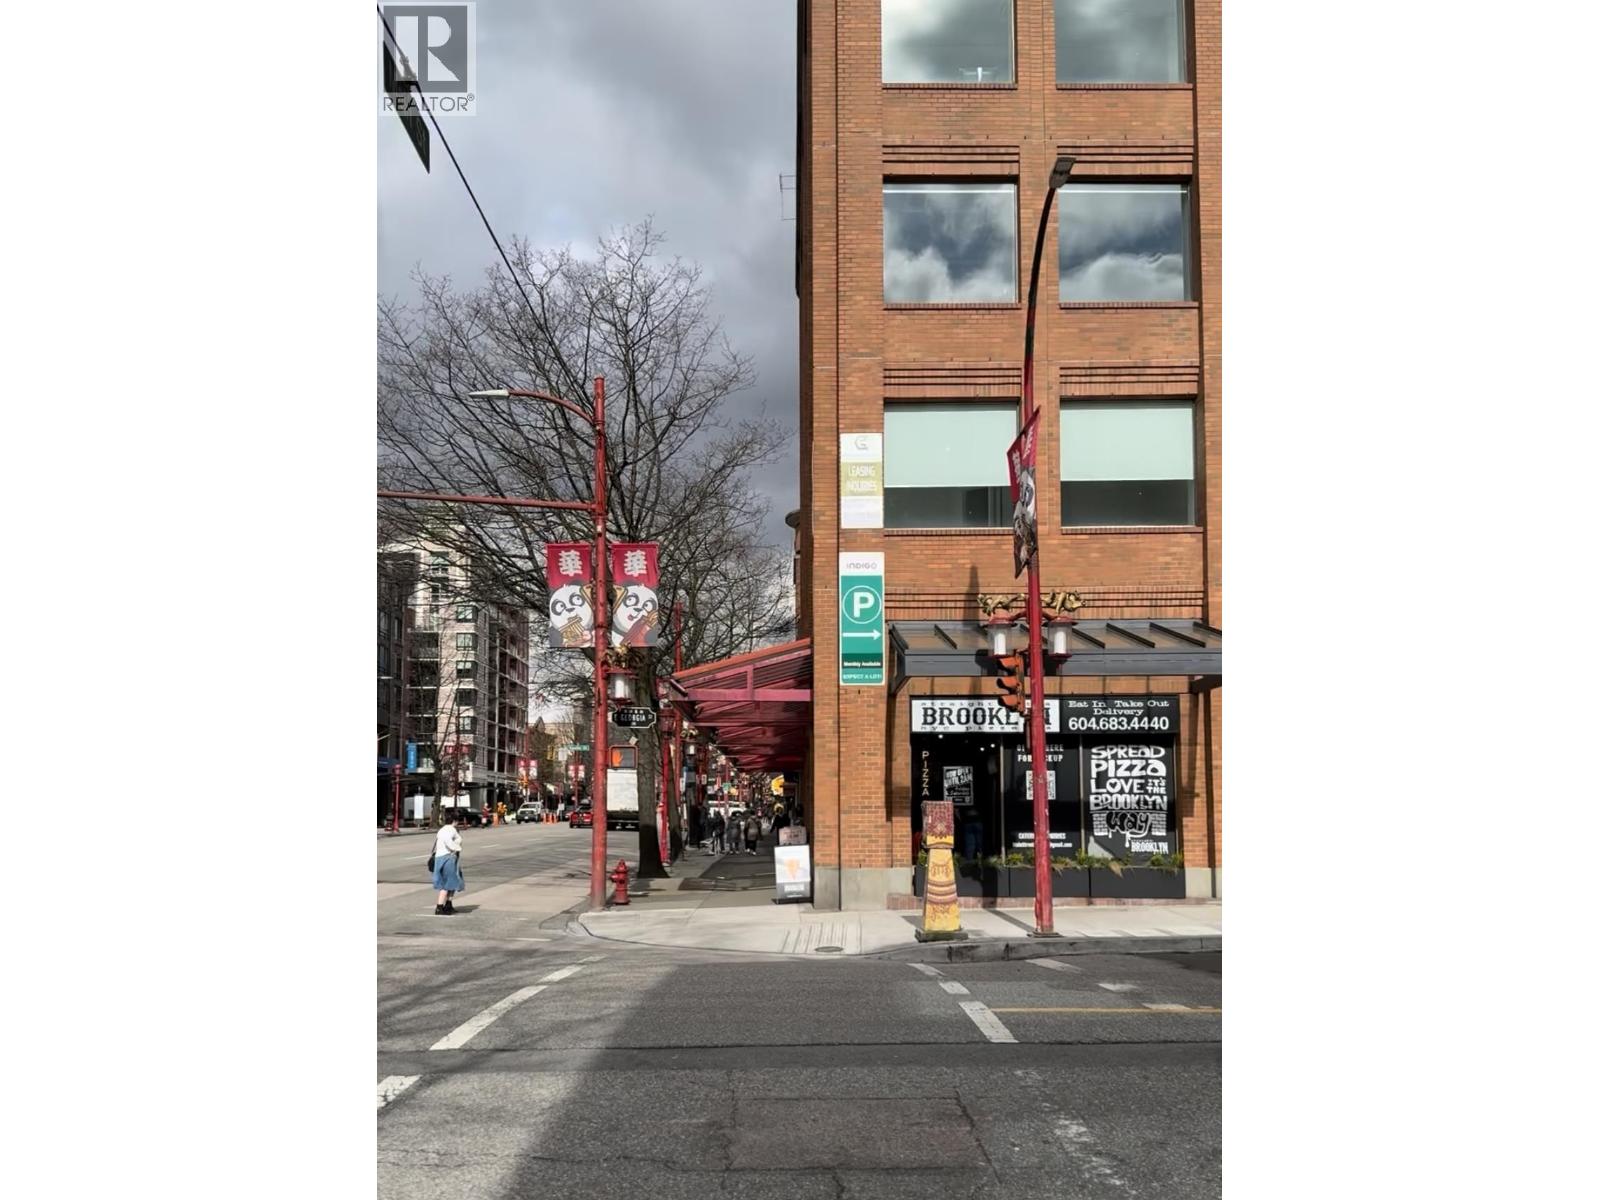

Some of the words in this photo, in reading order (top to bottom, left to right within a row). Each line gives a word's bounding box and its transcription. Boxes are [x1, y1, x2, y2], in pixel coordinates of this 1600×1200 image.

[848, 465, 876, 477] LEASING
[559, 550, 583, 577] 華
[624, 550, 647, 577] 華
[853, 591, 875, 618] P
[1068, 700, 1089, 708] Eat
[1092, 700, 1107, 708] In
[1114, 700, 1144, 708] Take
[620, 713, 646, 722] GEORGIA
[921, 707, 1052, 726] BROOKL
[1093, 708, 1144, 716] Delivery
[1068, 716, 1169, 730] 604.683.4440
[1017, 754, 1032, 762] FOR
[921, 750, 930, 797] PIZZA
[1090, 778, 1145, 793] LOVE
[1146, 786, 1166, 794] THE
[1089, 794, 1168, 811] BROOKLYN
[1131, 842, 1169, 854] BROOKLYN
